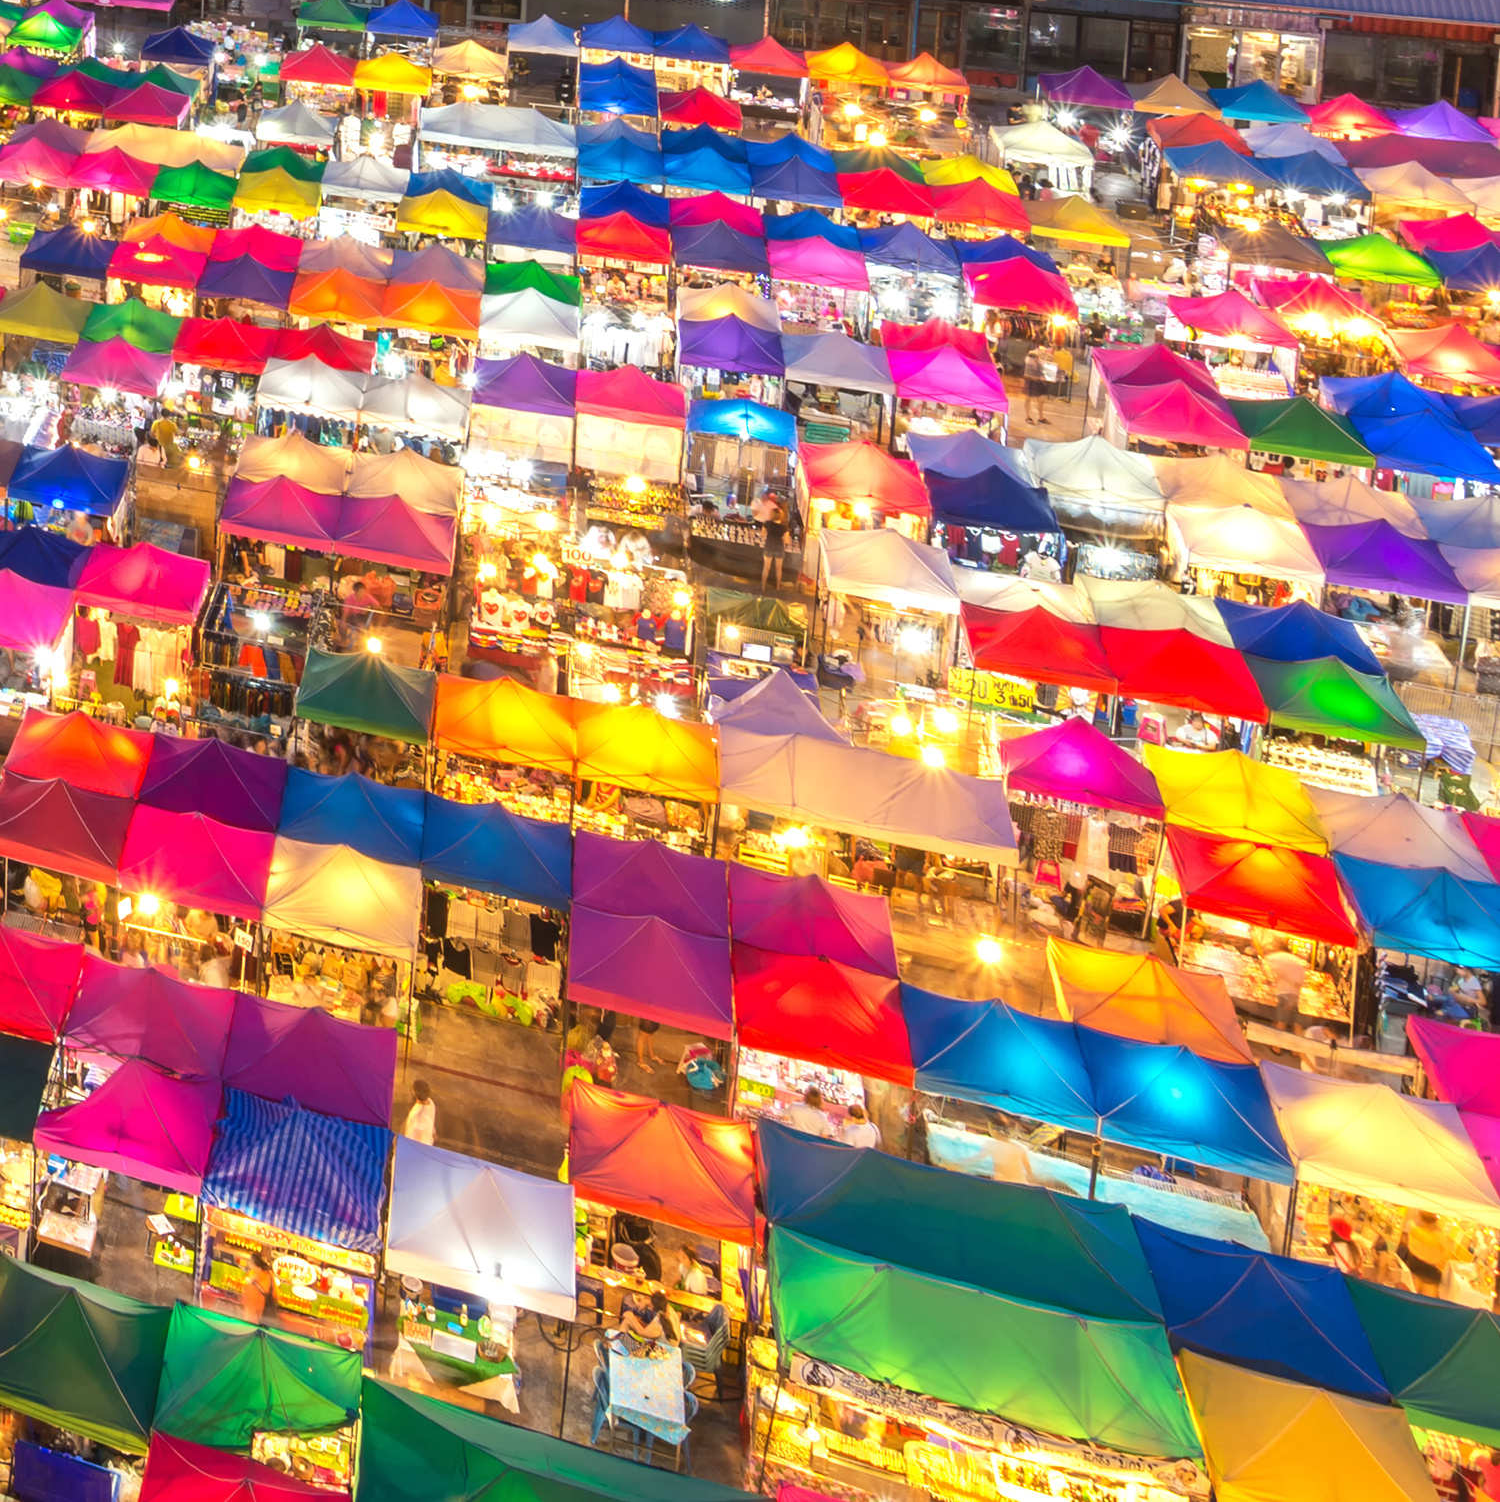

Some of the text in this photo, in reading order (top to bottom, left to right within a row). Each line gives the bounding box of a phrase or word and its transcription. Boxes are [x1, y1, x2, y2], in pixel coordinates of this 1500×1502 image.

[219, 377, 235, 389] 18
[565, 548, 592, 562] 100
[237, 934, 251, 948] 150
